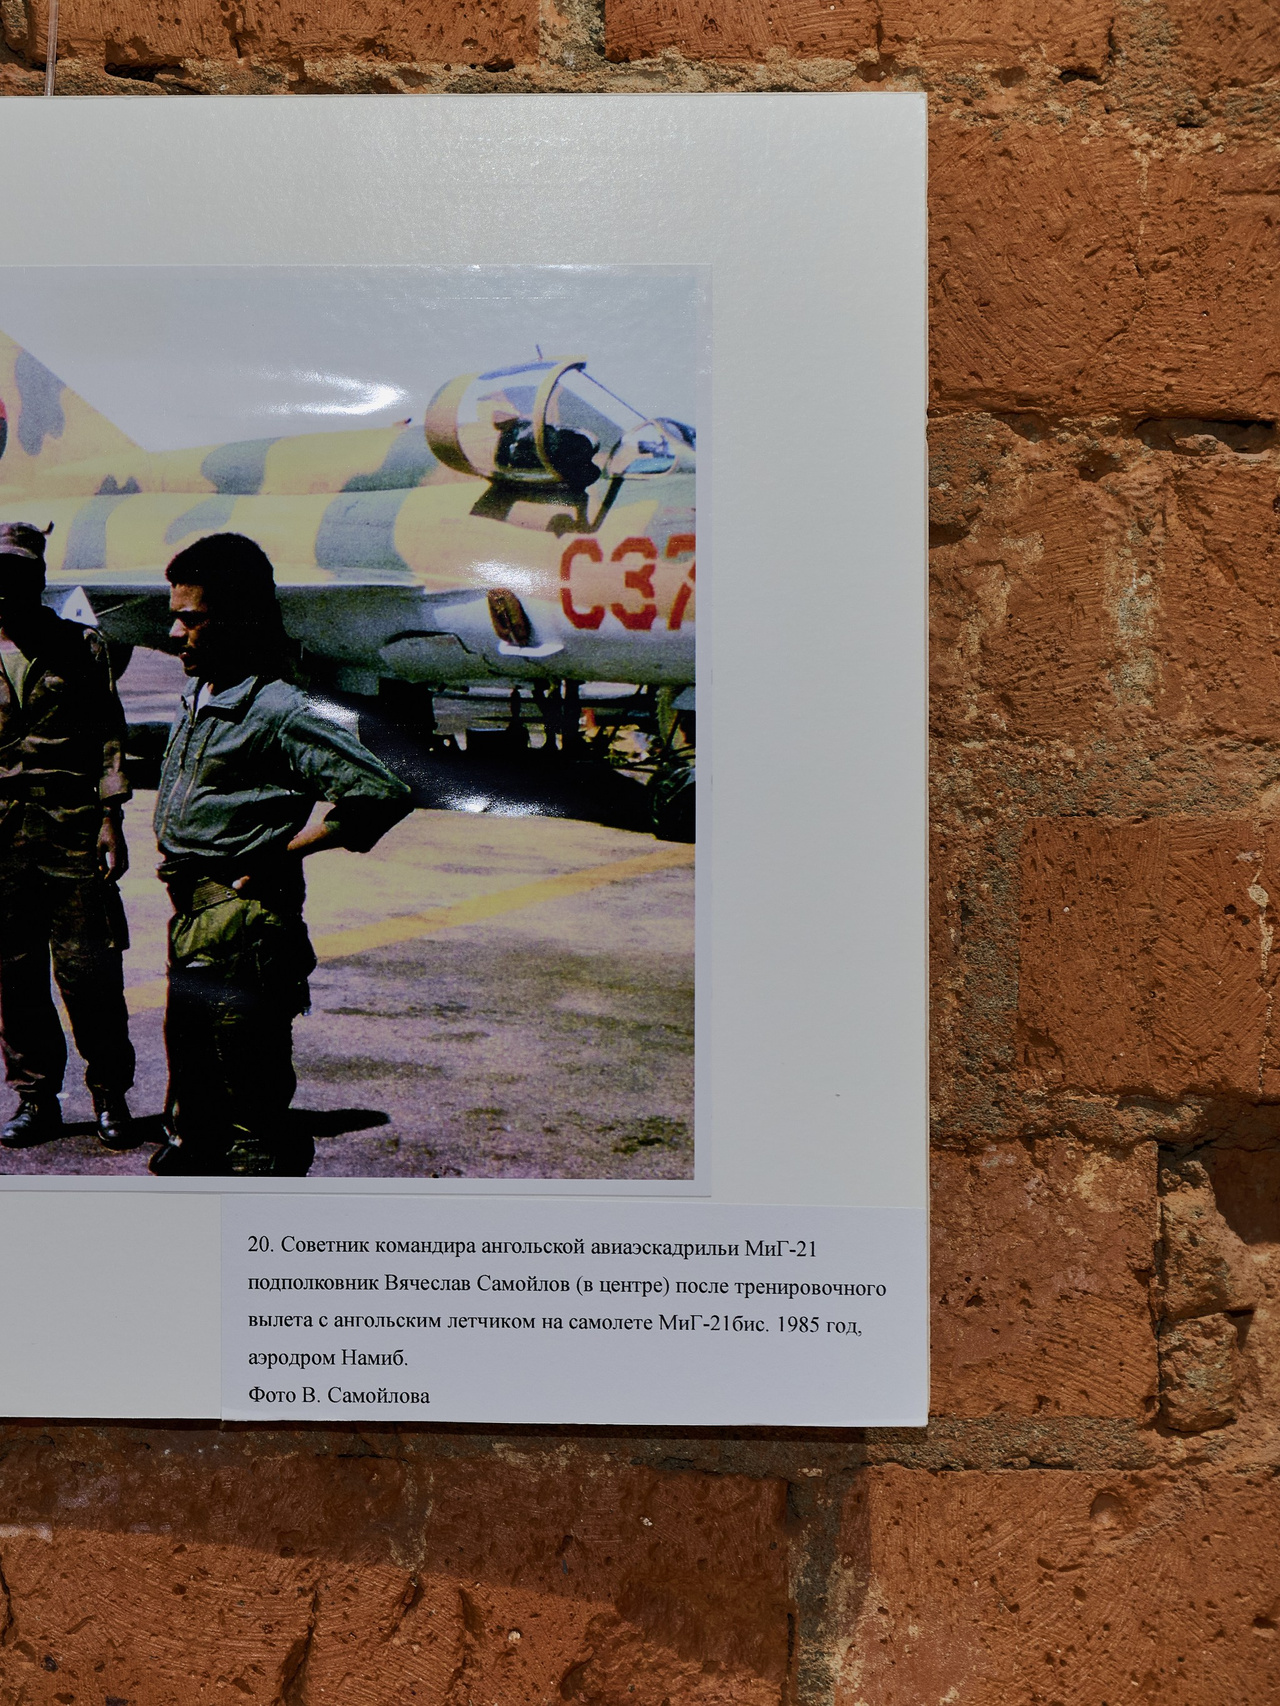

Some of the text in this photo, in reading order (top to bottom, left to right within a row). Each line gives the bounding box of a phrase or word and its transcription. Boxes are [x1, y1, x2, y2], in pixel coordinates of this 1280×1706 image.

[248, 1235, 817, 1260] 20. Советник командира ангольской авиаэскадрильи МиГ-21
[248, 1273, 887, 1300] подполковник Вячеслав Самойлов (в центре) после тренировочного
[248, 1313, 863, 1337] вылета с ангольским летчиком на самолете МиГ-21бис. 1985 год,
[248, 1348, 408, 1369] аэродром Намиб.
[248, 1385, 431, 1404] Фото В. Самойлова
